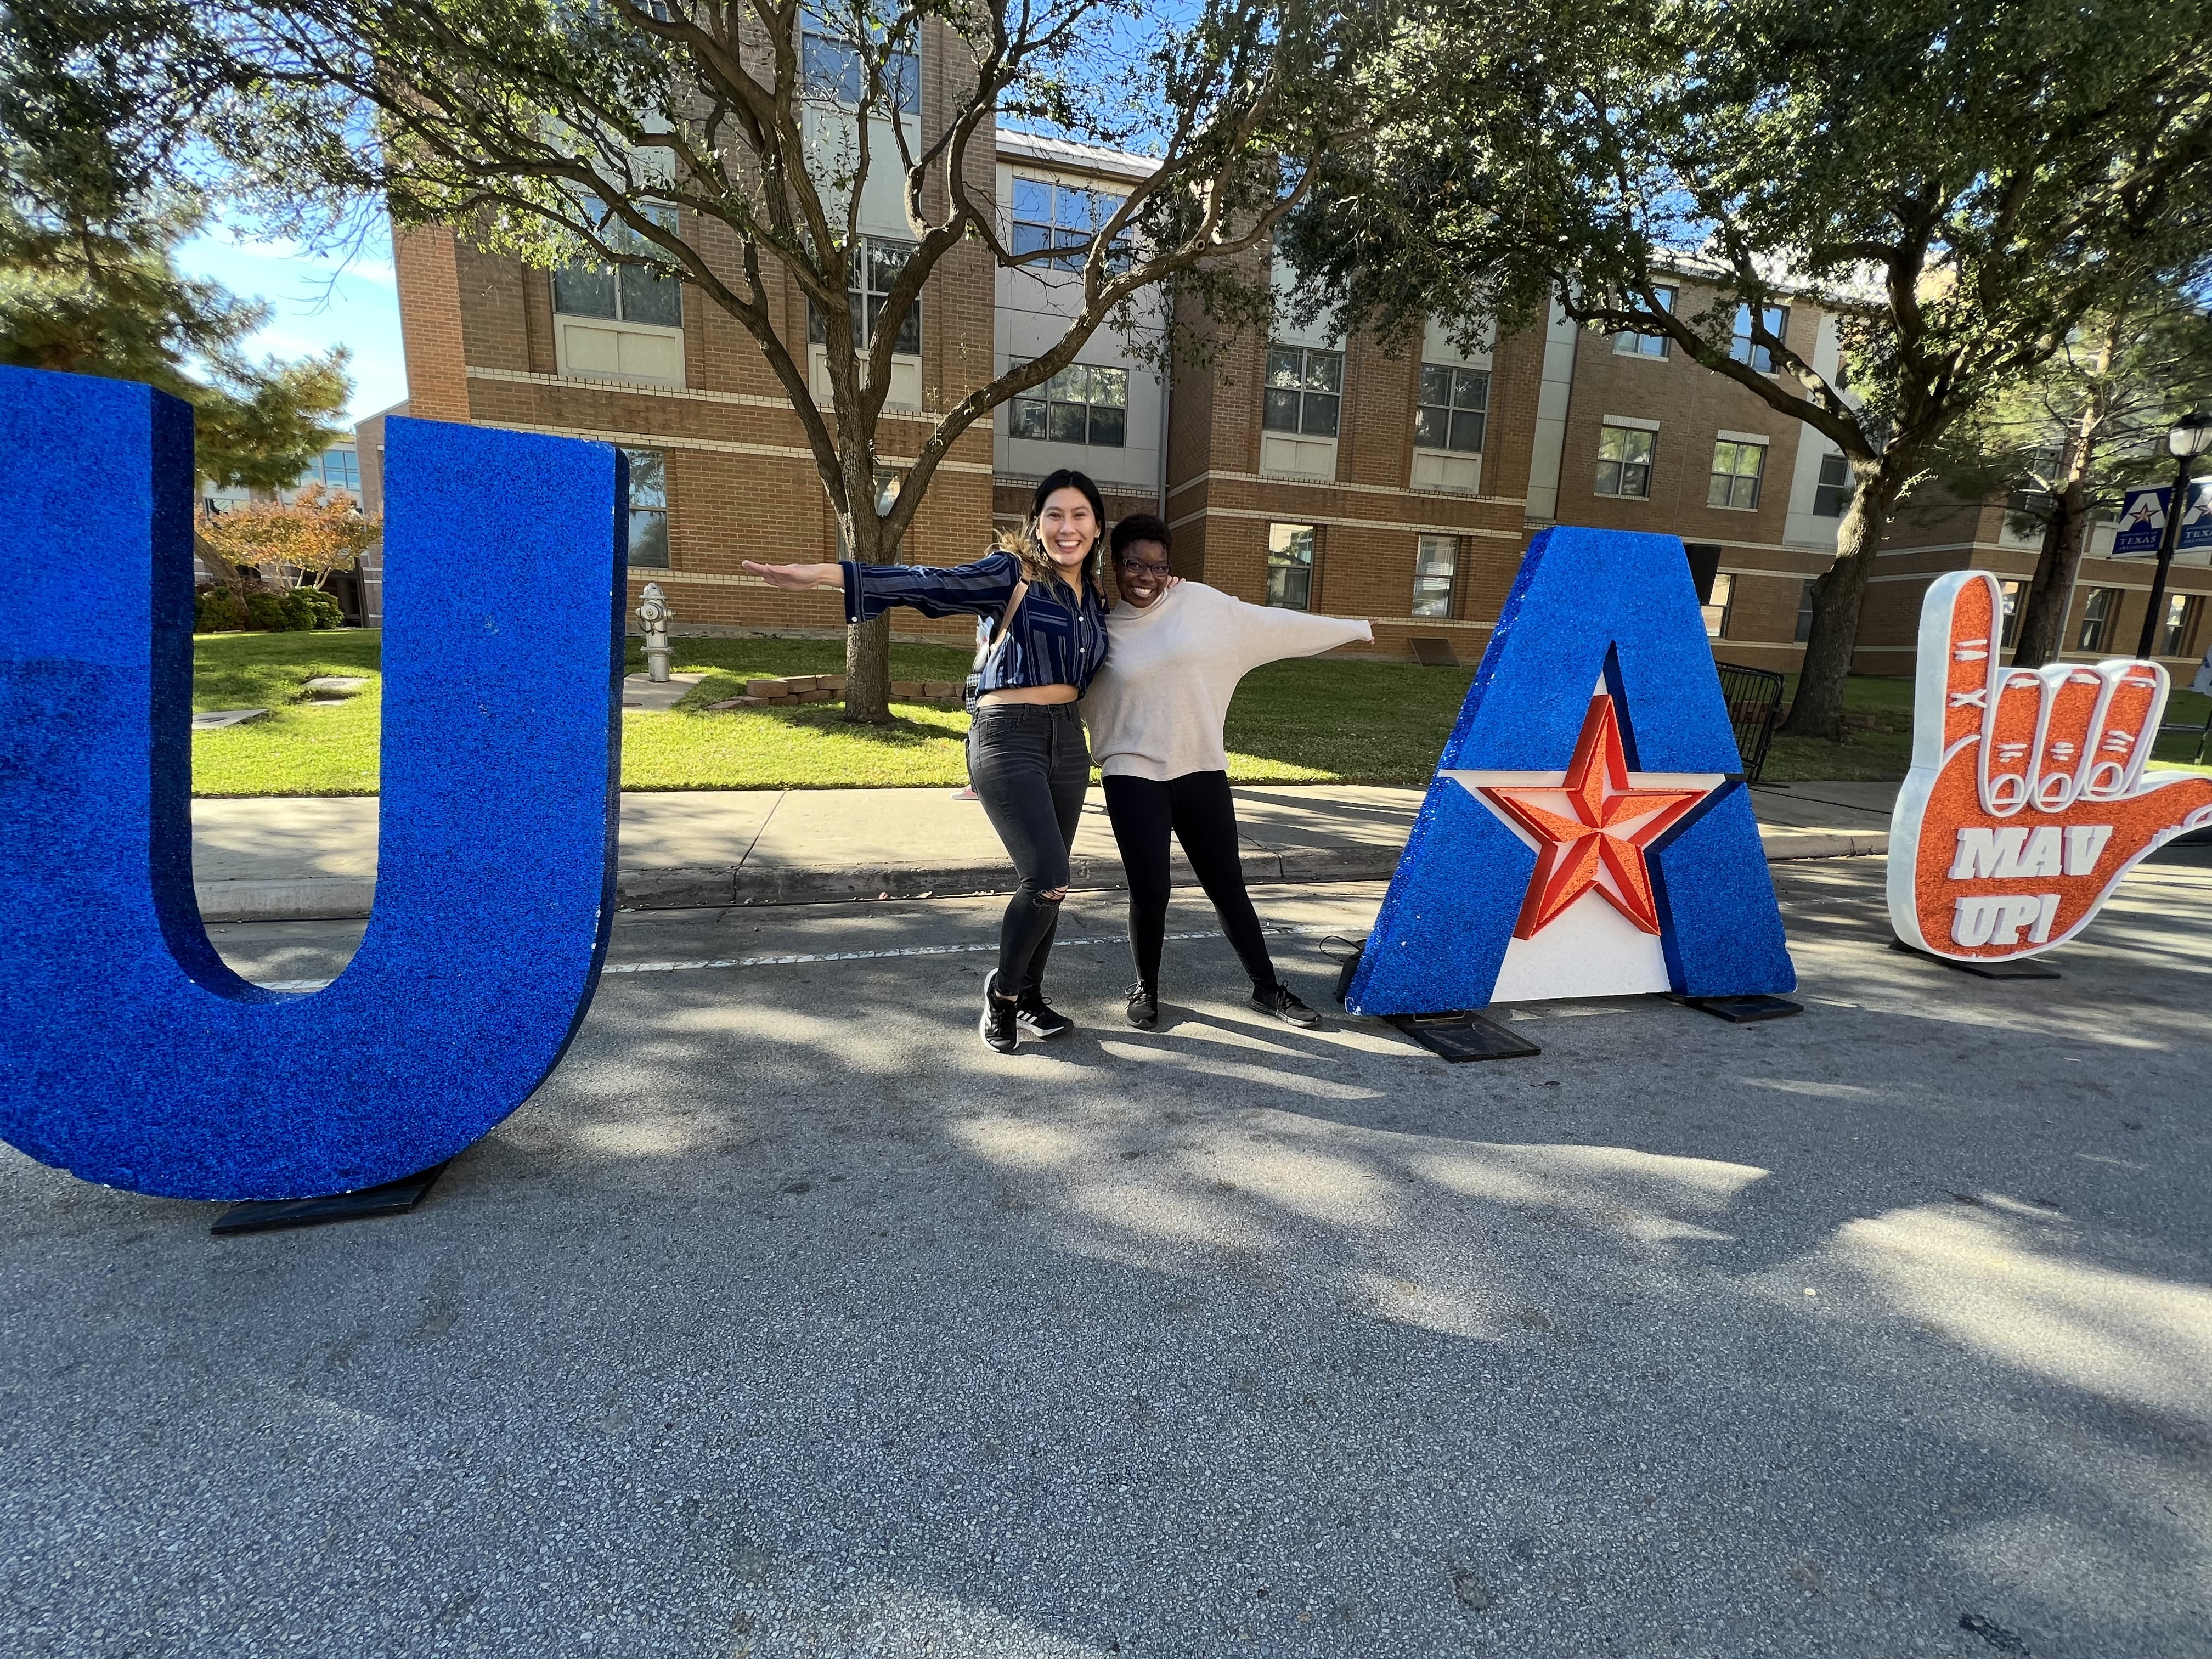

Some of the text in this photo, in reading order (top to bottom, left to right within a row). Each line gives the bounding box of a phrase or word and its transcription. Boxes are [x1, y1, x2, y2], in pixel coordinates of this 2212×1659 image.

[2120, 535, 2157, 545] TEXAS
[0, 365, 629, 1201] U
[1345, 525, 1798, 1016] A
[1948, 825, 2113, 880] MAV
